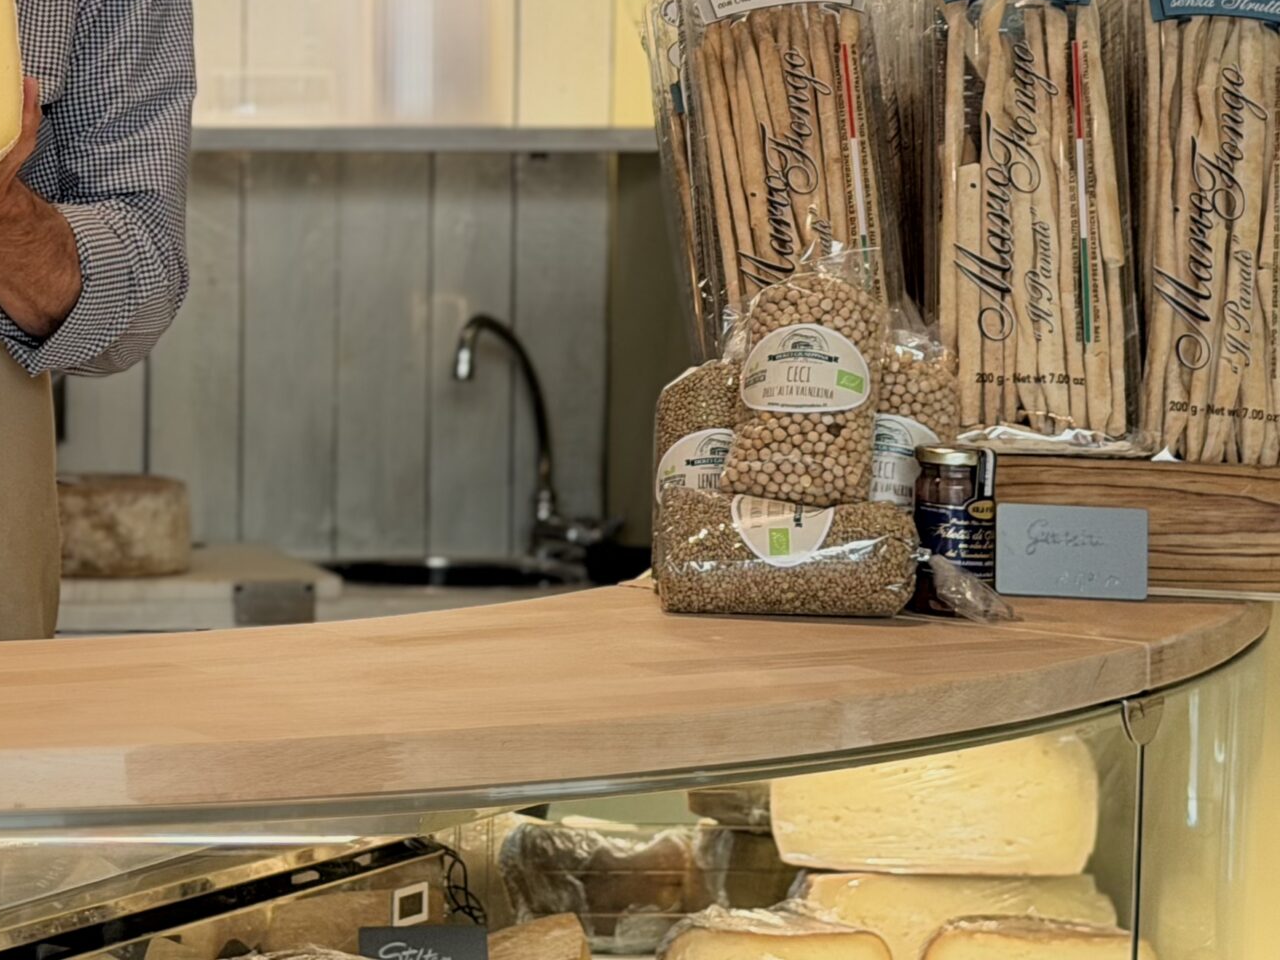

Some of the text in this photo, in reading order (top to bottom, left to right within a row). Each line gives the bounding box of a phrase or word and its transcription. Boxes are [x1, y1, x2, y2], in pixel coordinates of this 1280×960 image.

[953, 40, 1059, 341] Mario Fongo
[1153, 62, 1269, 370] Mario Fongo
[787, 366, 811, 383] CECI
[975, 372, 994, 384] 200
[996, 375, 1005, 387] g
[1013, 372, 1031, 384] Net
[1048, 372, 1070, 384] 7.00
[1073, 376, 1086, 386] oz
[1169, 400, 1189, 413] 200
[1191, 404, 1198, 417] g
[1206, 404, 1225, 416] Net
